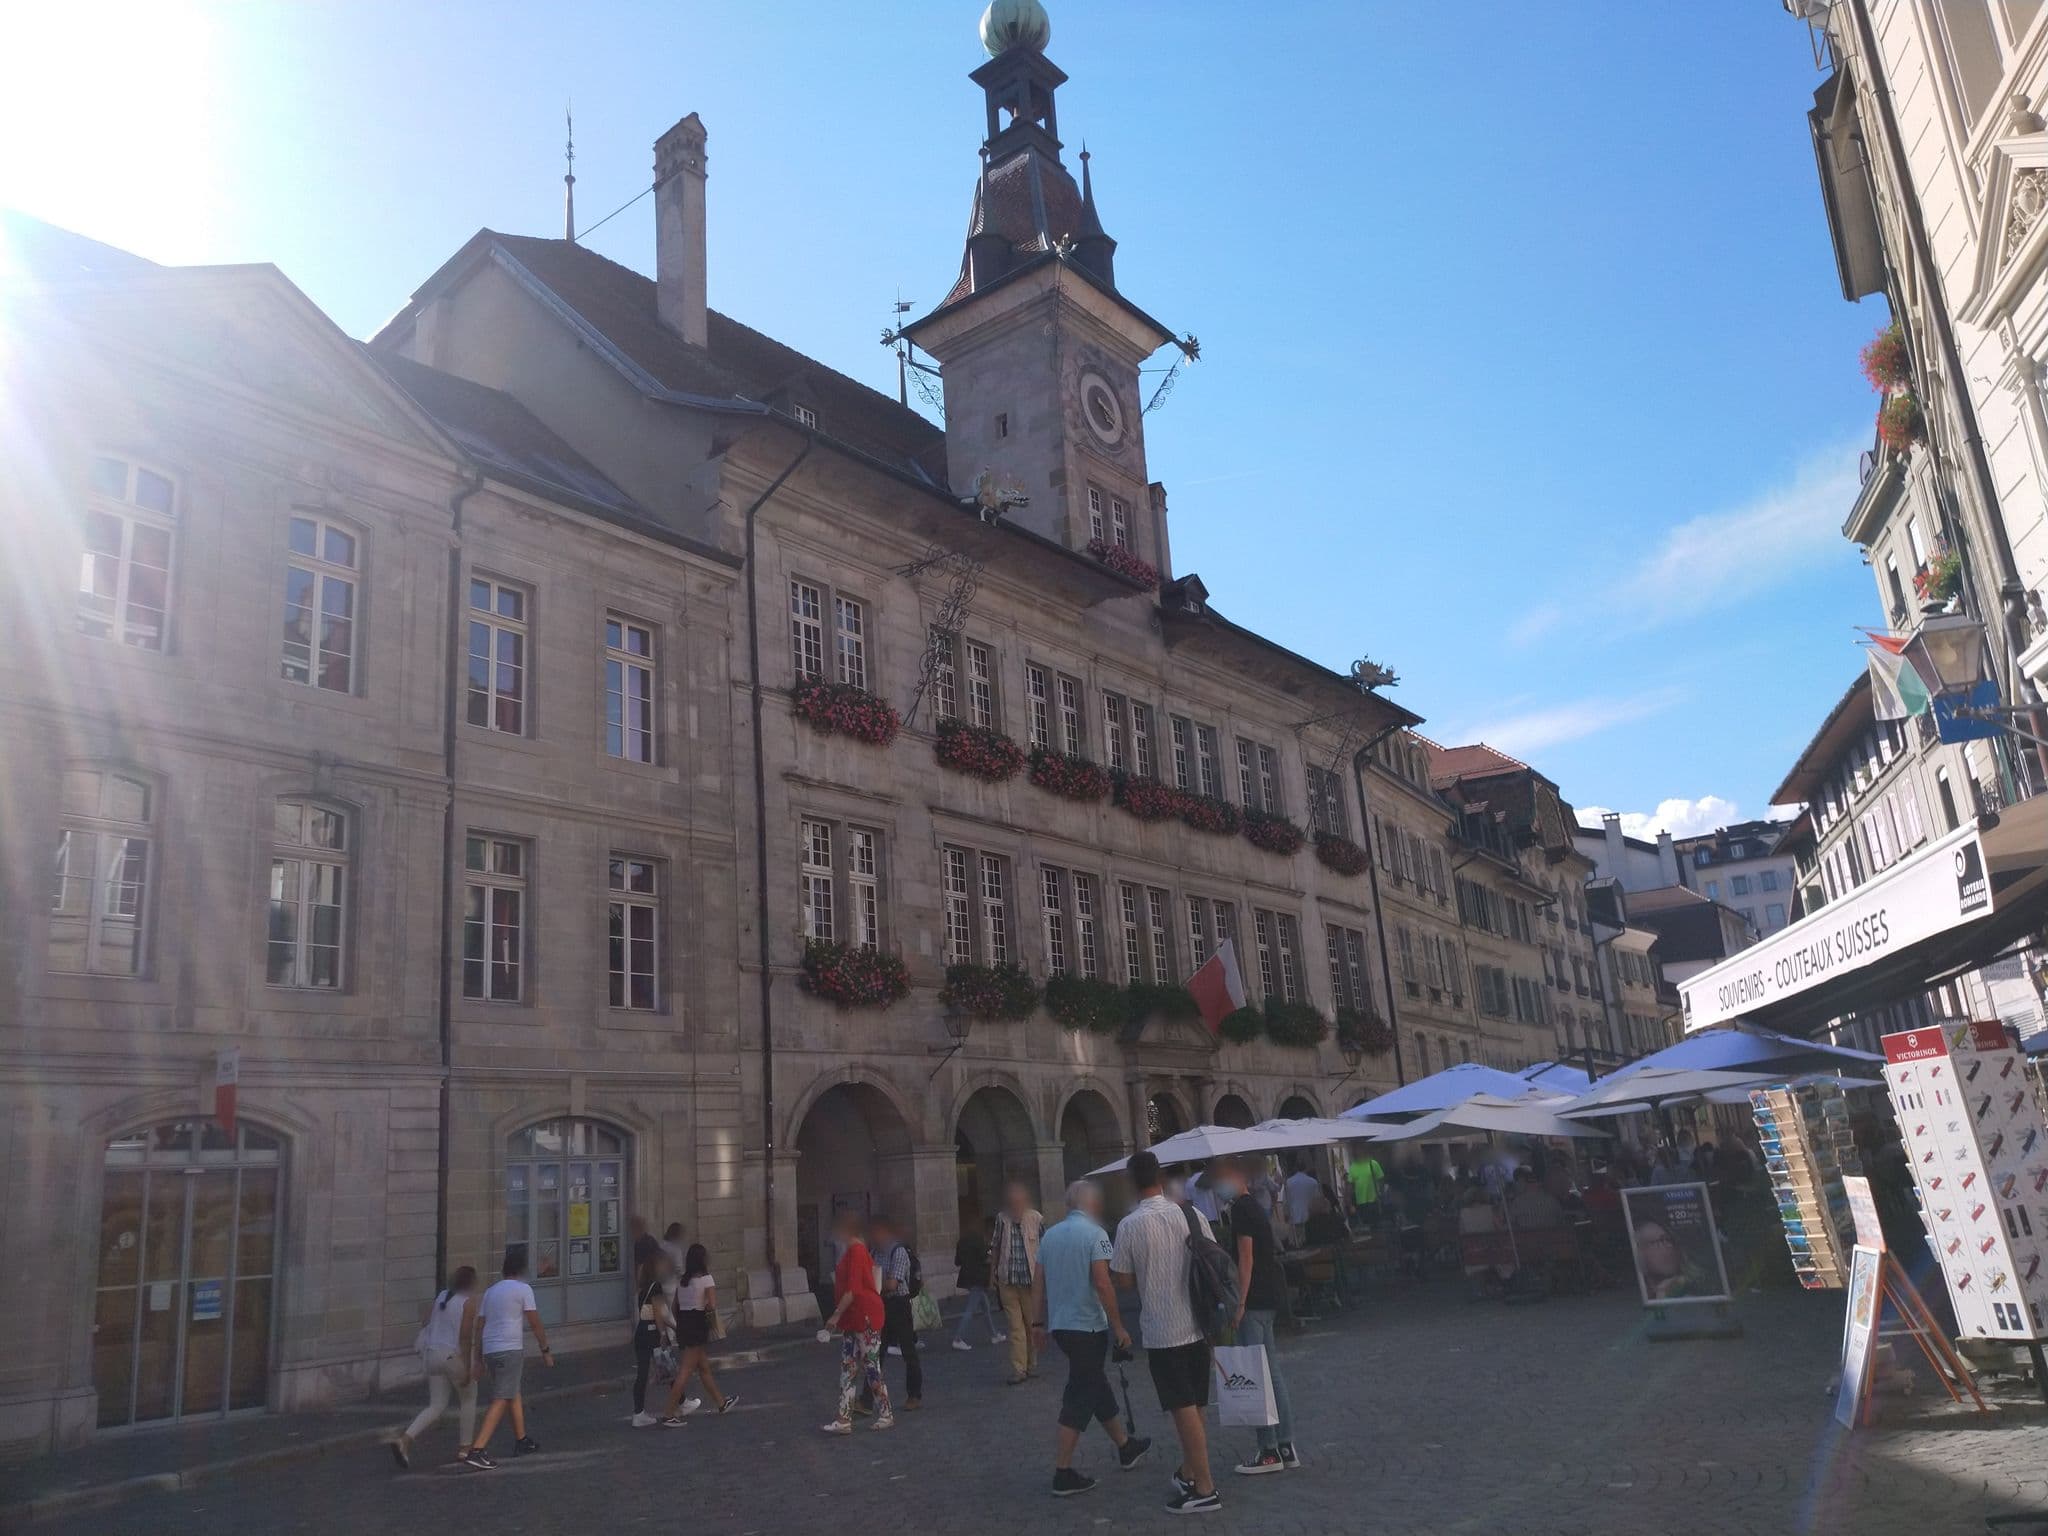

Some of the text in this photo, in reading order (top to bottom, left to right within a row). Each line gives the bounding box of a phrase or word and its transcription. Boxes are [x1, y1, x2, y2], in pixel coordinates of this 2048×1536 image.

[1718, 970, 1765, 1012] SOUVENIRS
[1775, 936, 1834, 989] COUTEAUX
[1835, 908, 1889, 963] SUISSES
[1896, 1047, 1938, 1061] VICTORINOX
